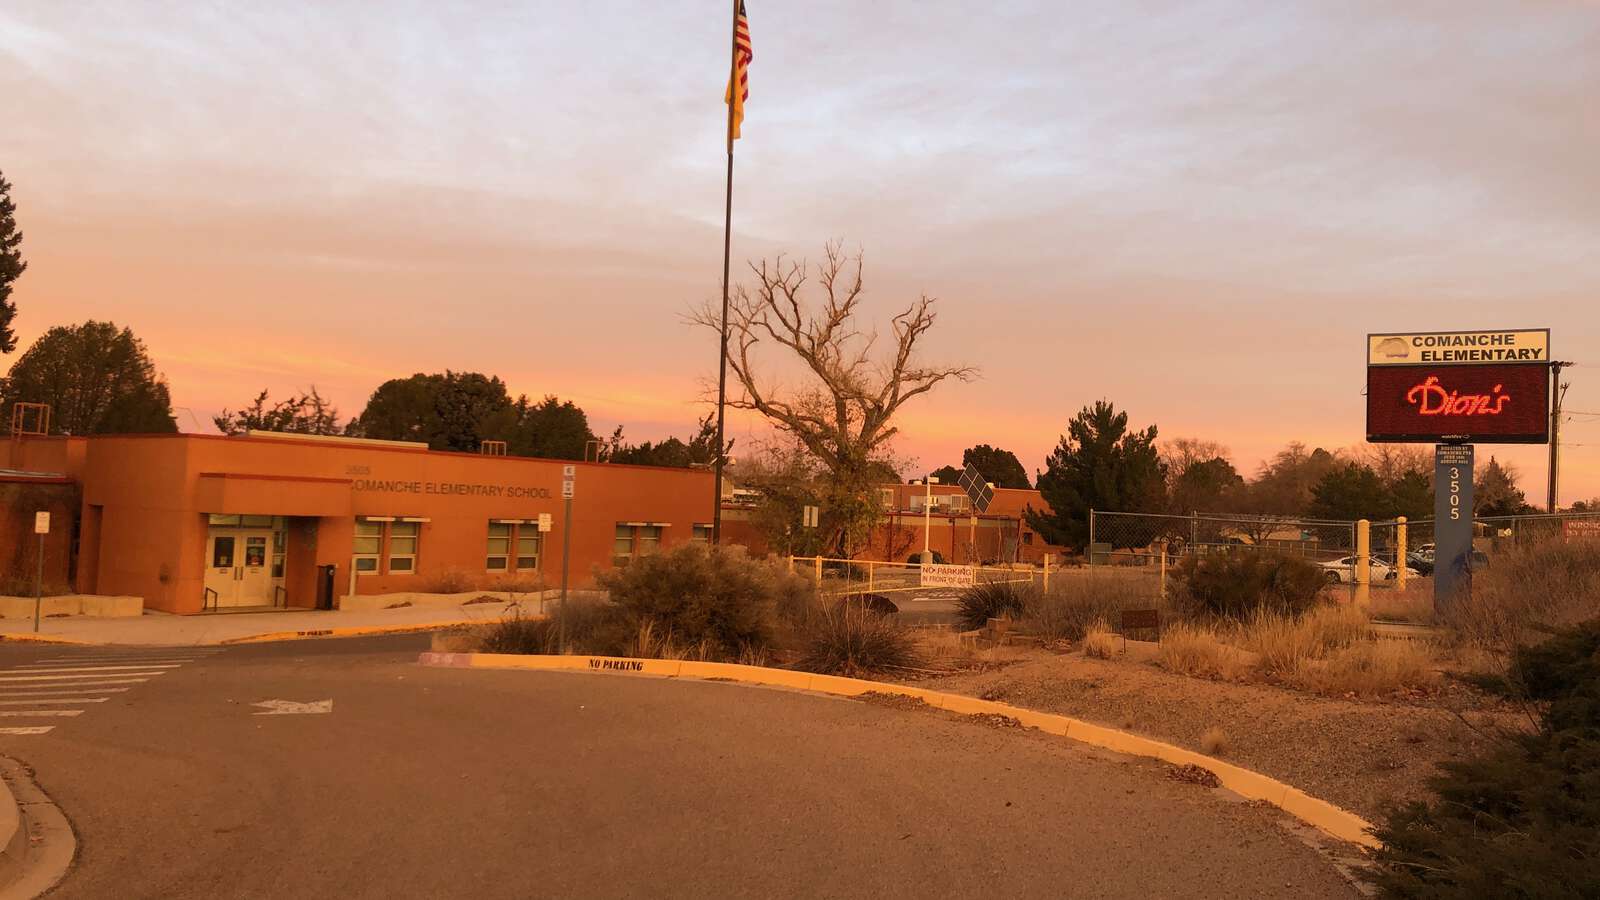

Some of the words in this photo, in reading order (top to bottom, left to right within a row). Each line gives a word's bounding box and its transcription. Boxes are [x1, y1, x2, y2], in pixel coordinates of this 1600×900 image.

[1412, 334, 1515, 347] COMANCHE
[1421, 348, 1543, 362] ELEMENTARY
[1407, 376, 1510, 415] Dion's
[351, 479, 421, 493] OMANCHE
[425, 482, 504, 496] ELEMENTARY
[507, 486, 553, 499] SCHOOL
[922, 566, 935, 574] NO
[937, 568, 972, 576] PARKING
[589, 659, 600, 668] NO
[603, 660, 644, 671] PARKING
